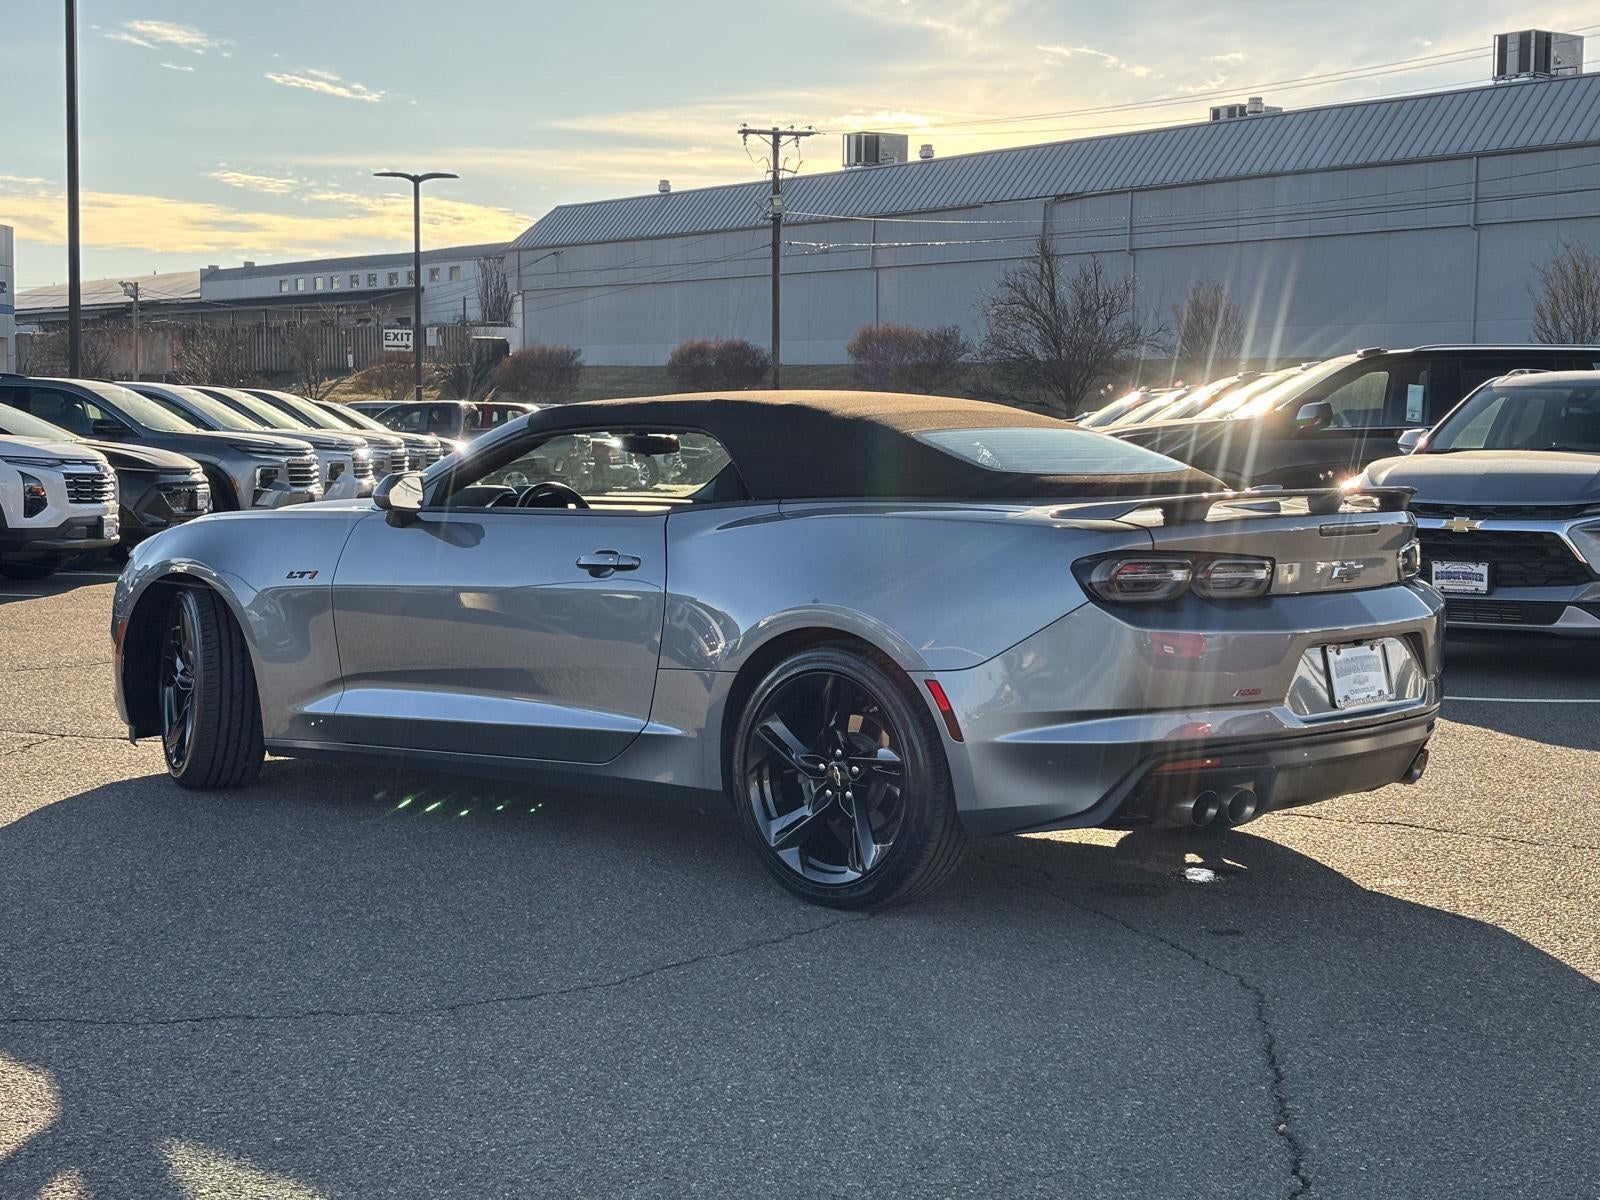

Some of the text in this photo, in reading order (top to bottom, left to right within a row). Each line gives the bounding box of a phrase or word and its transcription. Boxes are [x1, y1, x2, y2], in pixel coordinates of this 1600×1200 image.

[384, 332, 412, 342] EXIT
[286, 570, 319, 580] LT1
[1434, 571, 1484, 582] BRIDGEWATER
[1334, 655, 1382, 678] BRIDGEWATER
